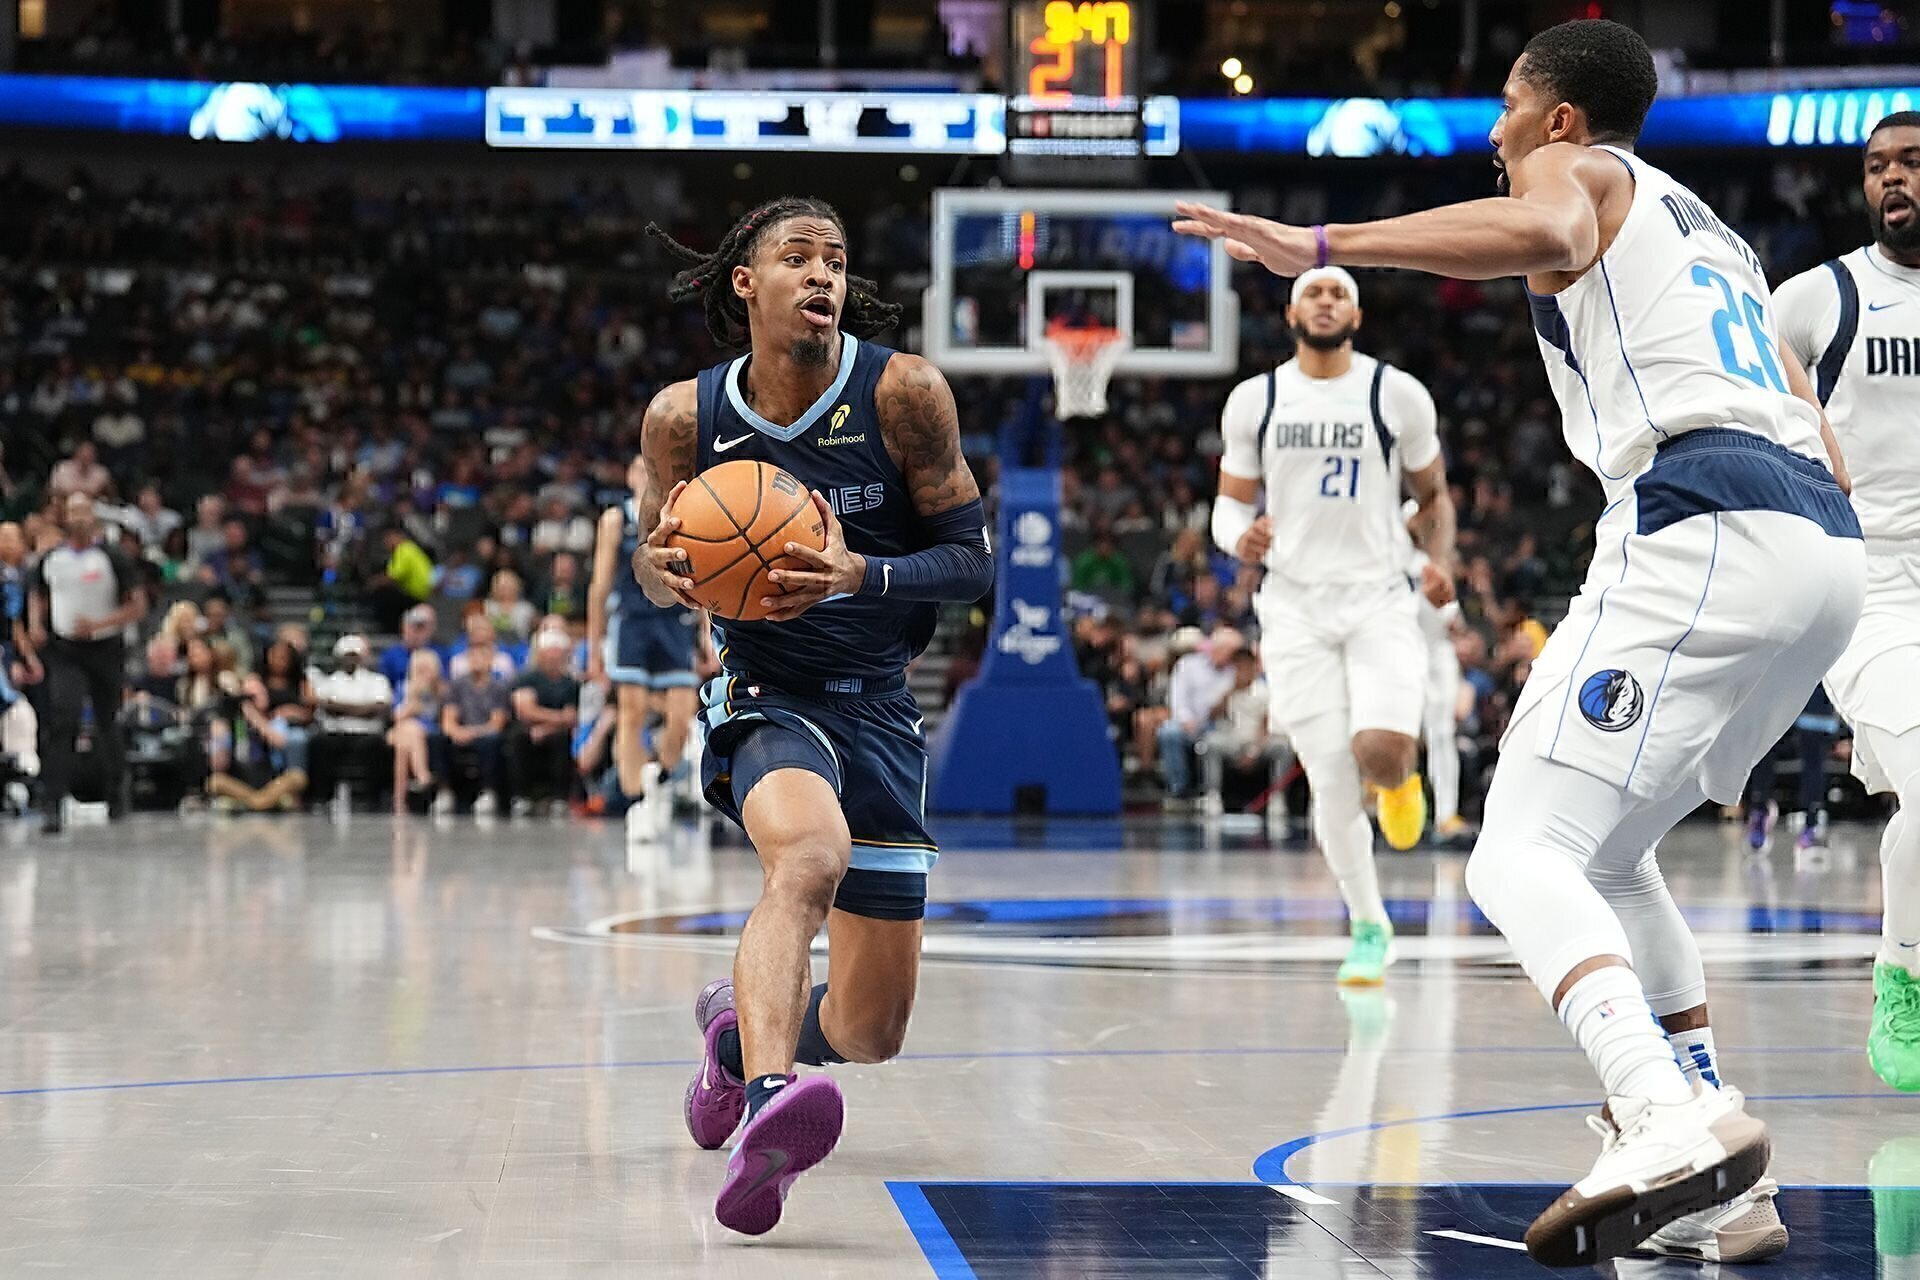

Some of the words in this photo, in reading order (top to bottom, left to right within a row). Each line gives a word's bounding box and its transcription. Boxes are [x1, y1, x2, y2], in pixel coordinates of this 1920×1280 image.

[1691, 264, 1791, 395] 26
[817, 433, 865, 447] Robinhood
[1276, 423, 1363, 449] DALLAS
[1320, 456, 1360, 498] 21
